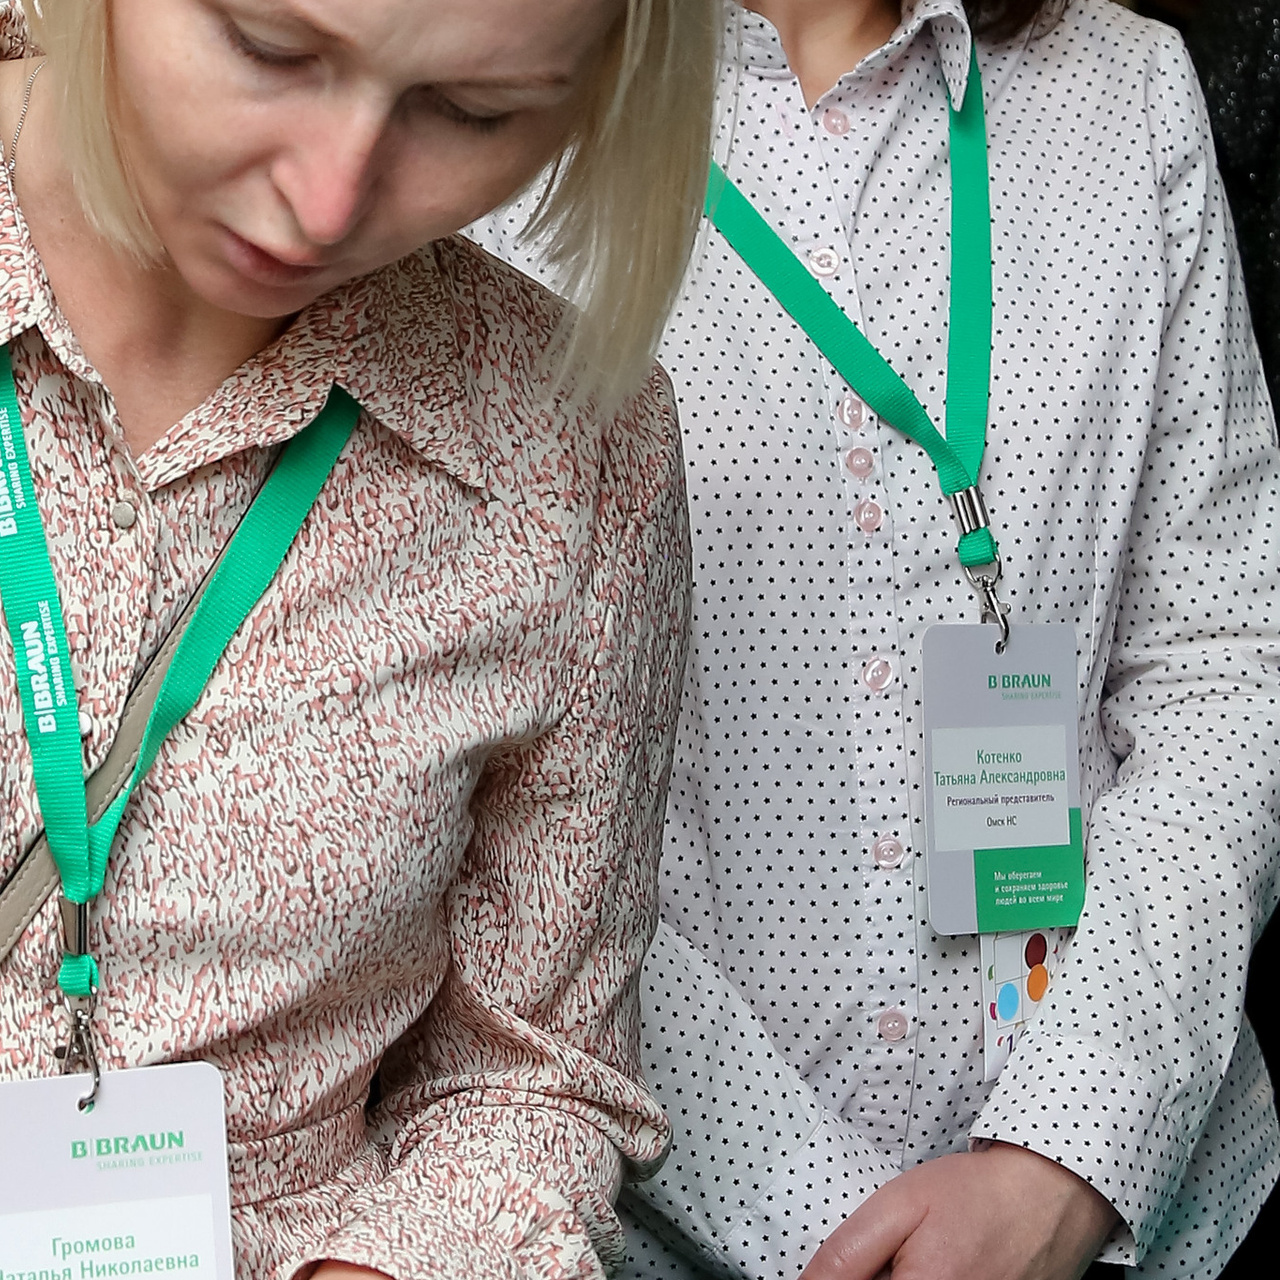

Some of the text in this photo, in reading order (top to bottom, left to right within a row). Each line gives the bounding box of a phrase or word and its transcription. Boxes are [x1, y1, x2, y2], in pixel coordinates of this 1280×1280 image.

[8, 461, 26, 509] SHARING
[20, 620, 54, 710] BRAUN
[37, 600, 67, 707] SHARING EXPERTISE
[1002, 674, 1051, 688] BRAUN
[977, 749, 1022, 764] Котенко
[934, 769, 1066, 786] Татьяна Александровна
[947, 793, 1055, 806] Региональный представитель
[986, 816, 1005, 827] Омск
[96, 1130, 184, 1157] BRAUN
[52, 1235, 135, 1260] Громова
[80, 1253, 200, 1279] Николаевна
